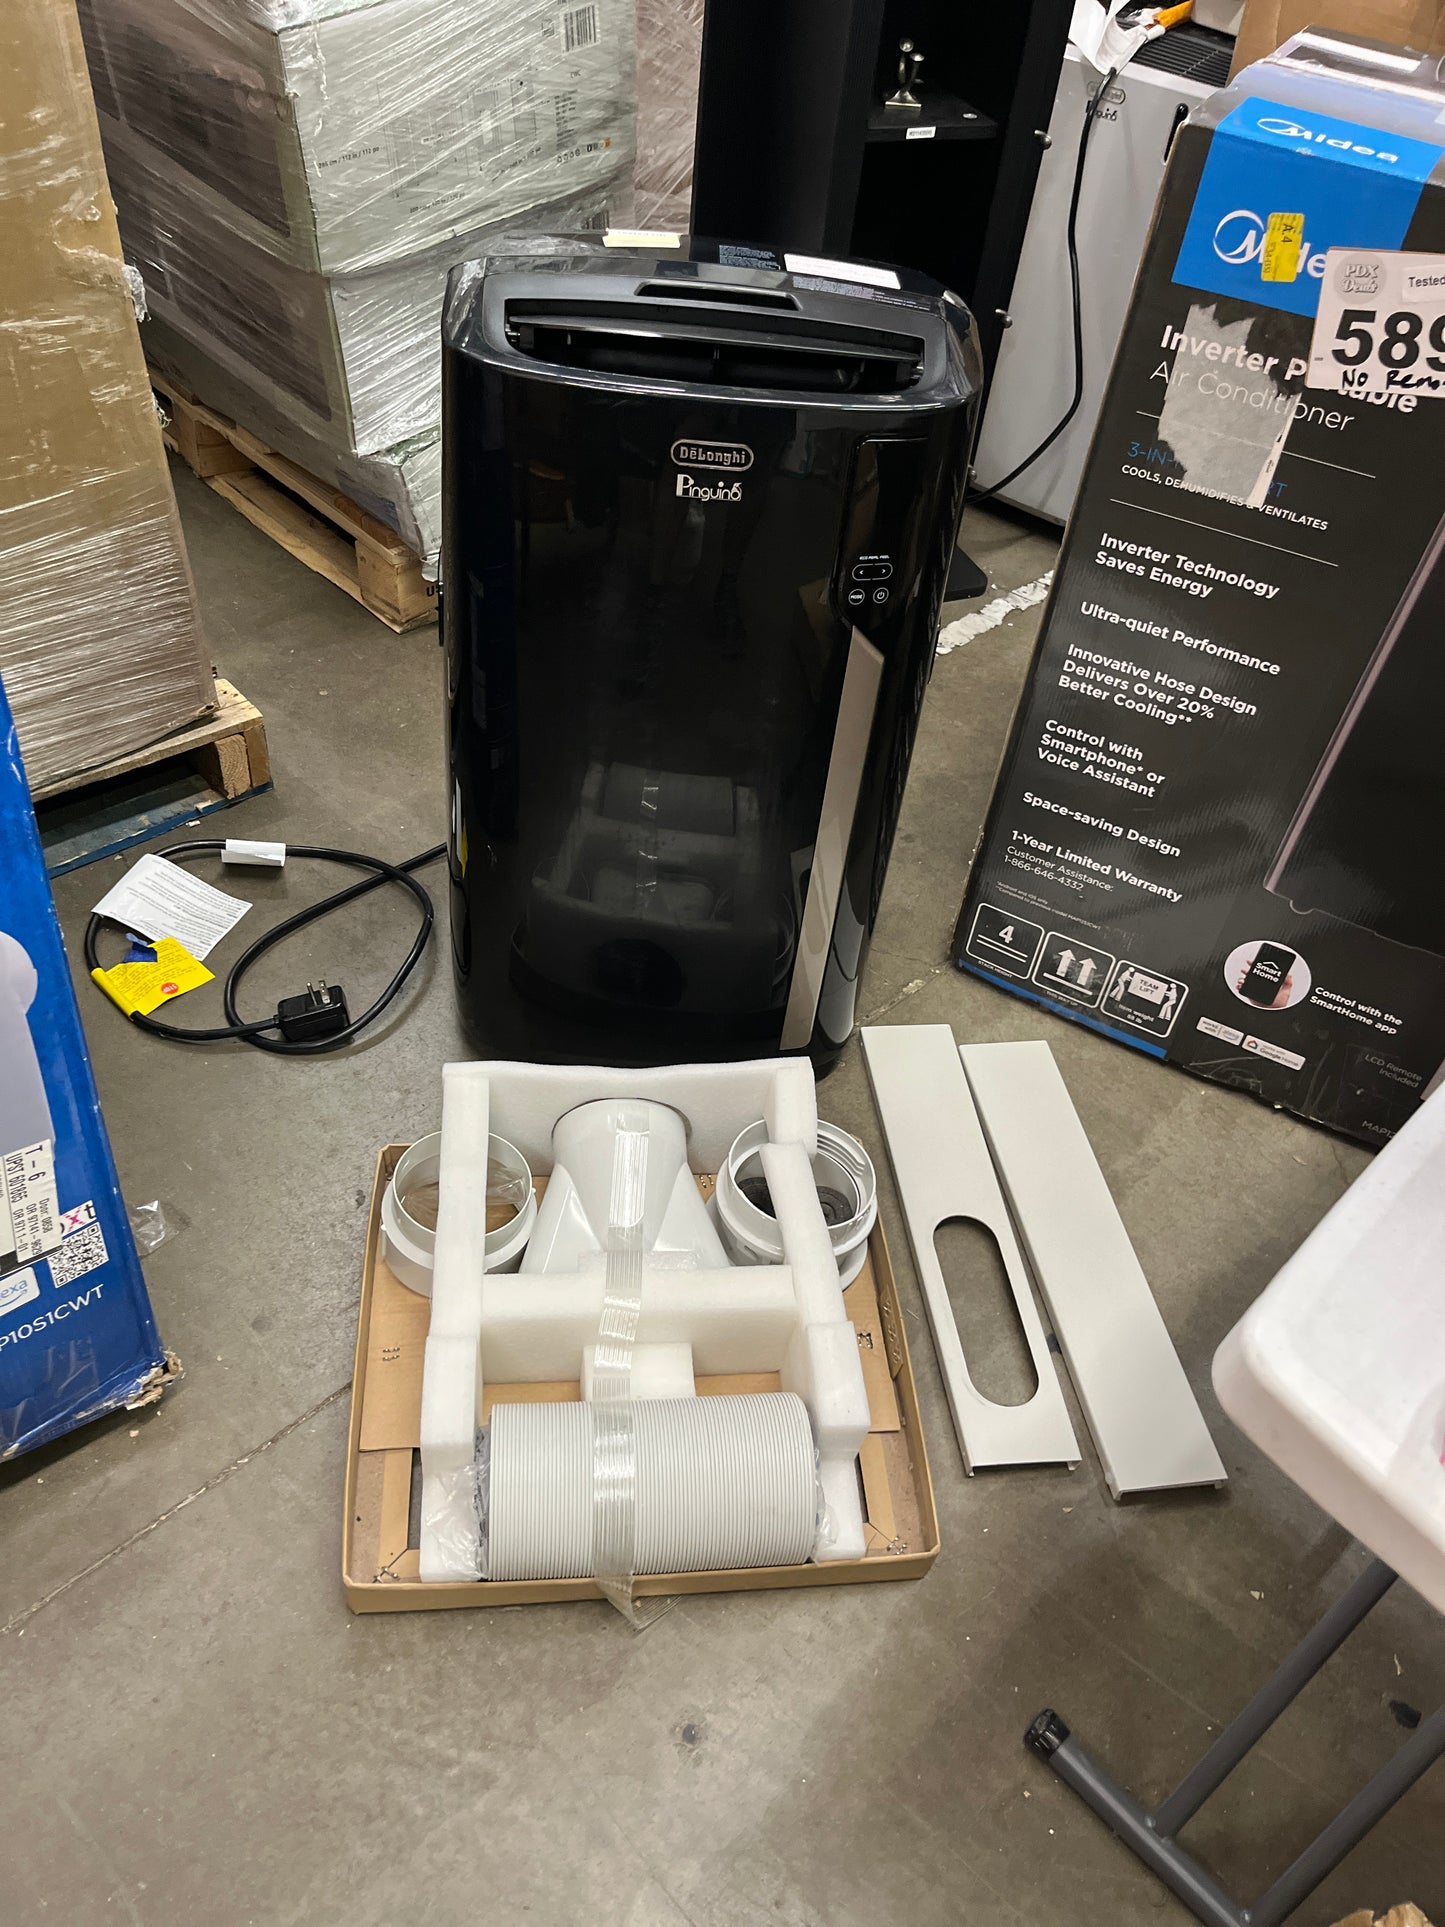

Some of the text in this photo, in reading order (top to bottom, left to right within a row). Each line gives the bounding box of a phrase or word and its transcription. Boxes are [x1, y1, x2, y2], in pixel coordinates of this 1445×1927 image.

[1257, 118, 1399, 164] Midea
[1345, 263, 1379, 279] PDX
[1160, 324, 1279, 375] Inverter
[1149, 360, 1355, 431] Air Conditioner
[1121, 464, 1162, 485] COOLS,
[1165, 476, 1244, 507] DEHUMIDIFIES
[1258, 503, 1329, 531] VENTILATES
[1095, 551, 1213, 598] Saves Energy
[1100, 533, 1280, 599] Inverter Technology
[1081, 601, 1281, 675] Ultra-quiet Performance
[1058, 675, 1110, 700] Better
[1063, 660, 1214, 719] Delivers Over 20%
[1068, 644, 1257, 715] Innovative Hose Design
[1045, 719, 1143, 761] Control with
[1037, 747, 1156, 798] Voice Assistant
[1146, 771, 1166, 785] or
[1022, 791, 1181, 857] Space-saving Design
[1003, 855, 1084, 892] 1-866-646-4332
[1006, 845, 1114, 892] Customer Assistance:
[1011, 830, 1184, 903] 1-Year Limited Warranty
[998, 925, 1015, 944] 4
[1139, 979, 1159, 995] TEAM LIFT
[1252, 967, 1279, 983] Home
[1255, 962, 1282, 977] Smart
[1310, 995, 1397, 1035] SmartHome app
[1315, 986, 1403, 1025] Control with the
[1260, 1047, 1281, 1060] Google
[1364, 1053, 1422, 1081] LCD Remote
[1379, 1068, 1419, 1088] Included
